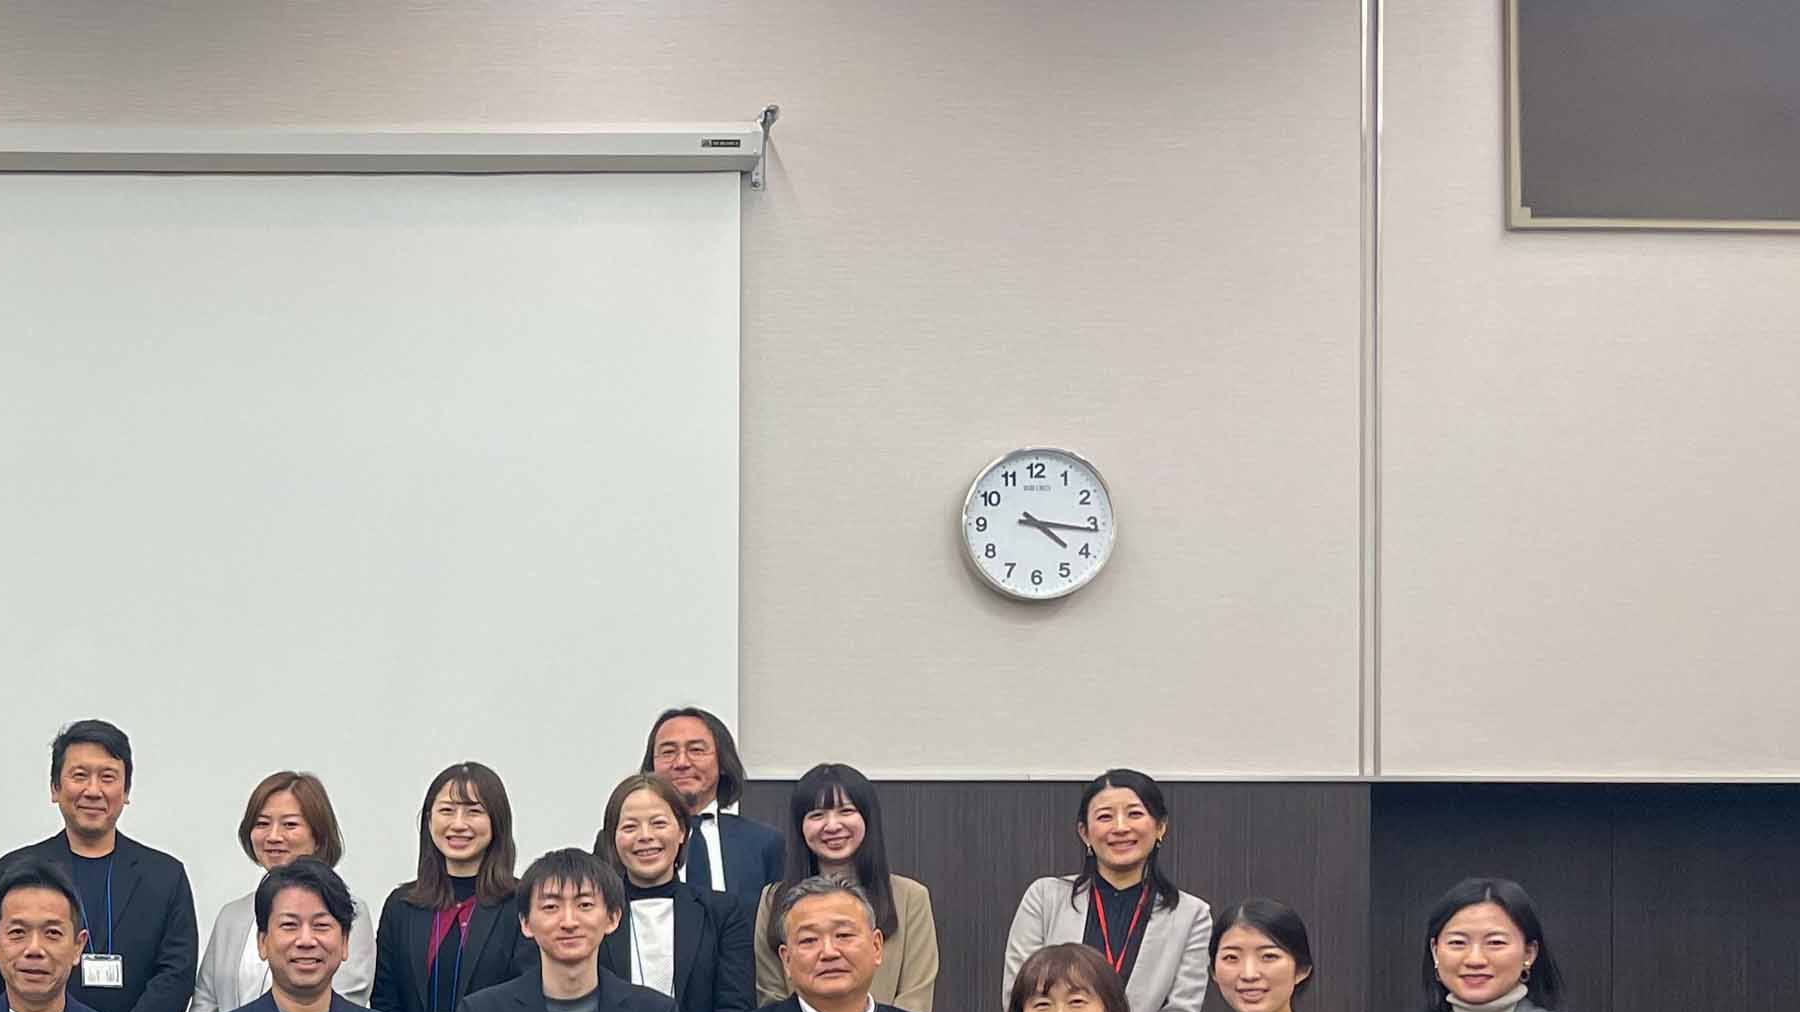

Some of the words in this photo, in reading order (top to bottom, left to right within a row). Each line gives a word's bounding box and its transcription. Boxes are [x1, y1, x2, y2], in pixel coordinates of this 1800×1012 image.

[1001, 471, 1017, 487] 11
[1026, 463, 1046, 479] 12
[1060, 470, 1069, 487] 1
[980, 491, 1001, 507] 10
[1079, 489, 1091, 505] 2
[975, 516, 988, 532] 9
[1087, 516, 1099, 531] 3
[984, 543, 997, 559] 8
[1078, 543, 1091, 558] 4
[1004, 562, 1017, 578] 7
[1030, 570, 1043, 586] 6
[1058, 562, 1071, 578] 5
